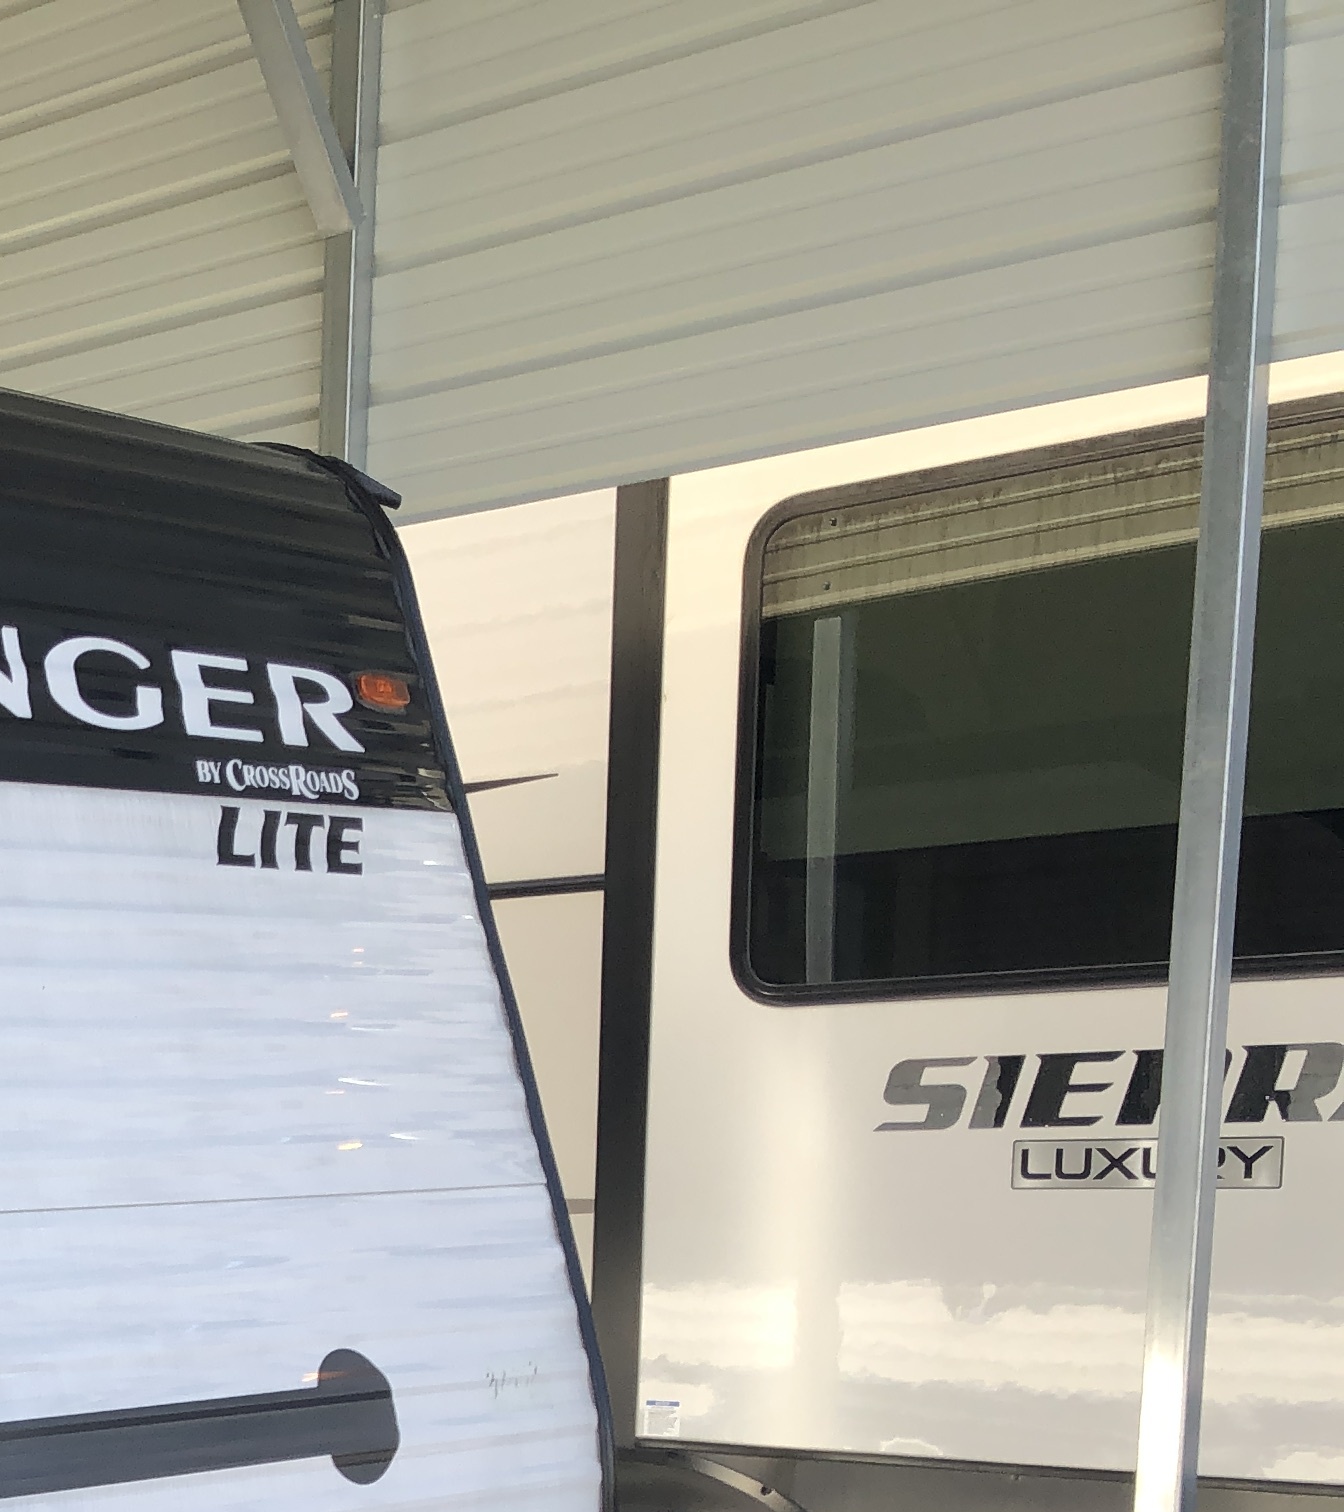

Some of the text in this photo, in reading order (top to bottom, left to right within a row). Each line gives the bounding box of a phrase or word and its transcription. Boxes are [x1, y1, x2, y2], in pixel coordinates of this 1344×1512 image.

[196, 759, 222, 784] BY
[216, 804, 364, 876] LITE
[872, 1042, 1344, 1132] SIER
[1020, 1145, 1275, 1181] LUXY
